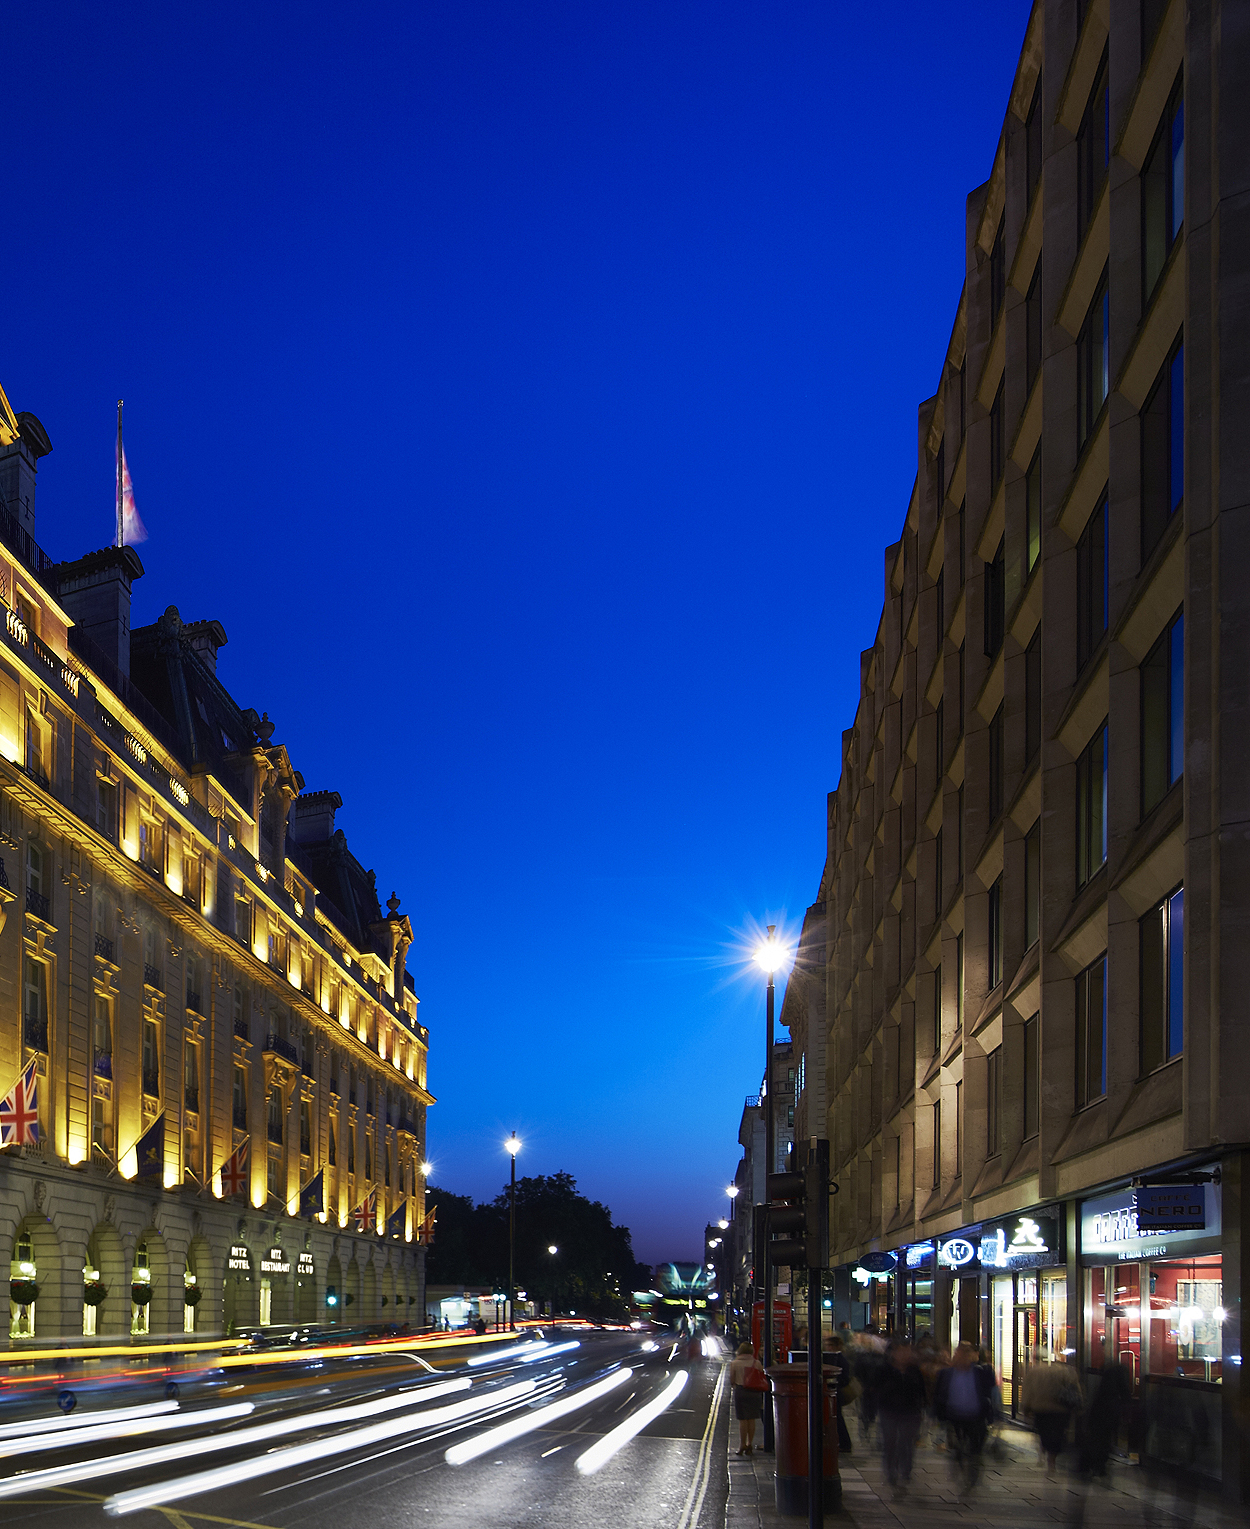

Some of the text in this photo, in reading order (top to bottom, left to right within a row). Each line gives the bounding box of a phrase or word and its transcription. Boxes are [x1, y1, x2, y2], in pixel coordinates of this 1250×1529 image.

[1140, 1205, 1202, 1216] NERO
[231, 1246, 248, 1258] RITZ
[270, 1248, 282, 1260] RITZ
[299, 1253, 313, 1263] RITZ
[1118, 1251, 1126, 1260] THE
[1142, 1247, 1159, 1257] COFFEE
[228, 1258, 250, 1270] HOTEL
[260, 1260, 291, 1273] RESTAURANT
[297, 1264, 314, 1275] CLUB
